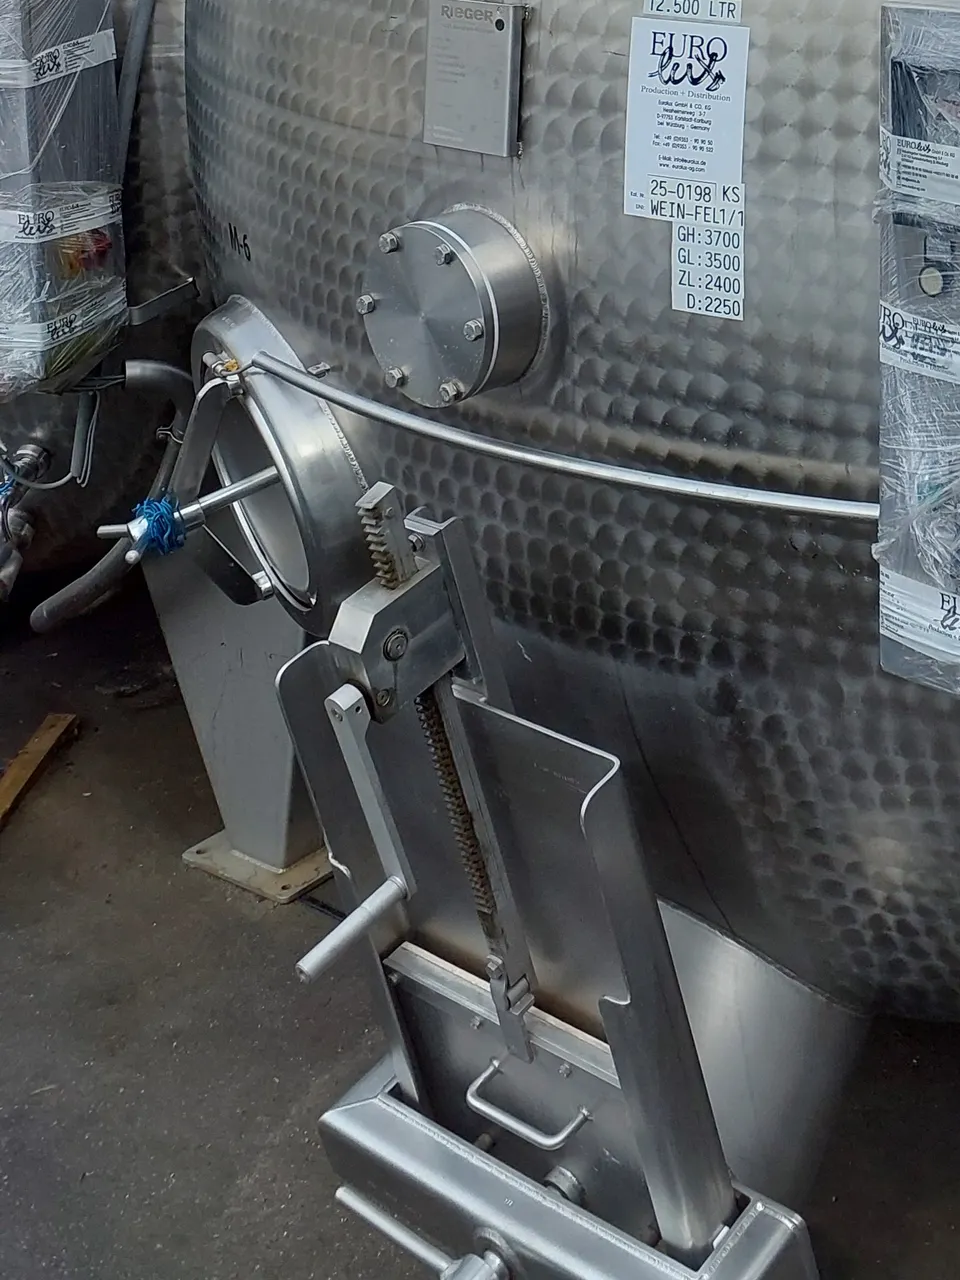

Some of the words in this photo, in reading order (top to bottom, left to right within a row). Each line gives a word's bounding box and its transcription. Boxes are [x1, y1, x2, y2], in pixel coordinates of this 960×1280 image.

[709, 0, 736, 19] LTR
[650, 31, 727, 62] EURO
[647, 46, 726, 92] lux
[640, 85, 679, 97] Production
[687, 90, 731, 102] Distribution
[650, 179, 711, 203] 25-0198
[722, 185, 740, 203] KS
[650, 199, 744, 227] WEIN-FEL1/1
[677, 225, 740, 249] GH:3700
[677, 248, 741, 272] GL:3500
[678, 269, 741, 295] ZL:2400
[687, 293, 741, 317] D:2250
